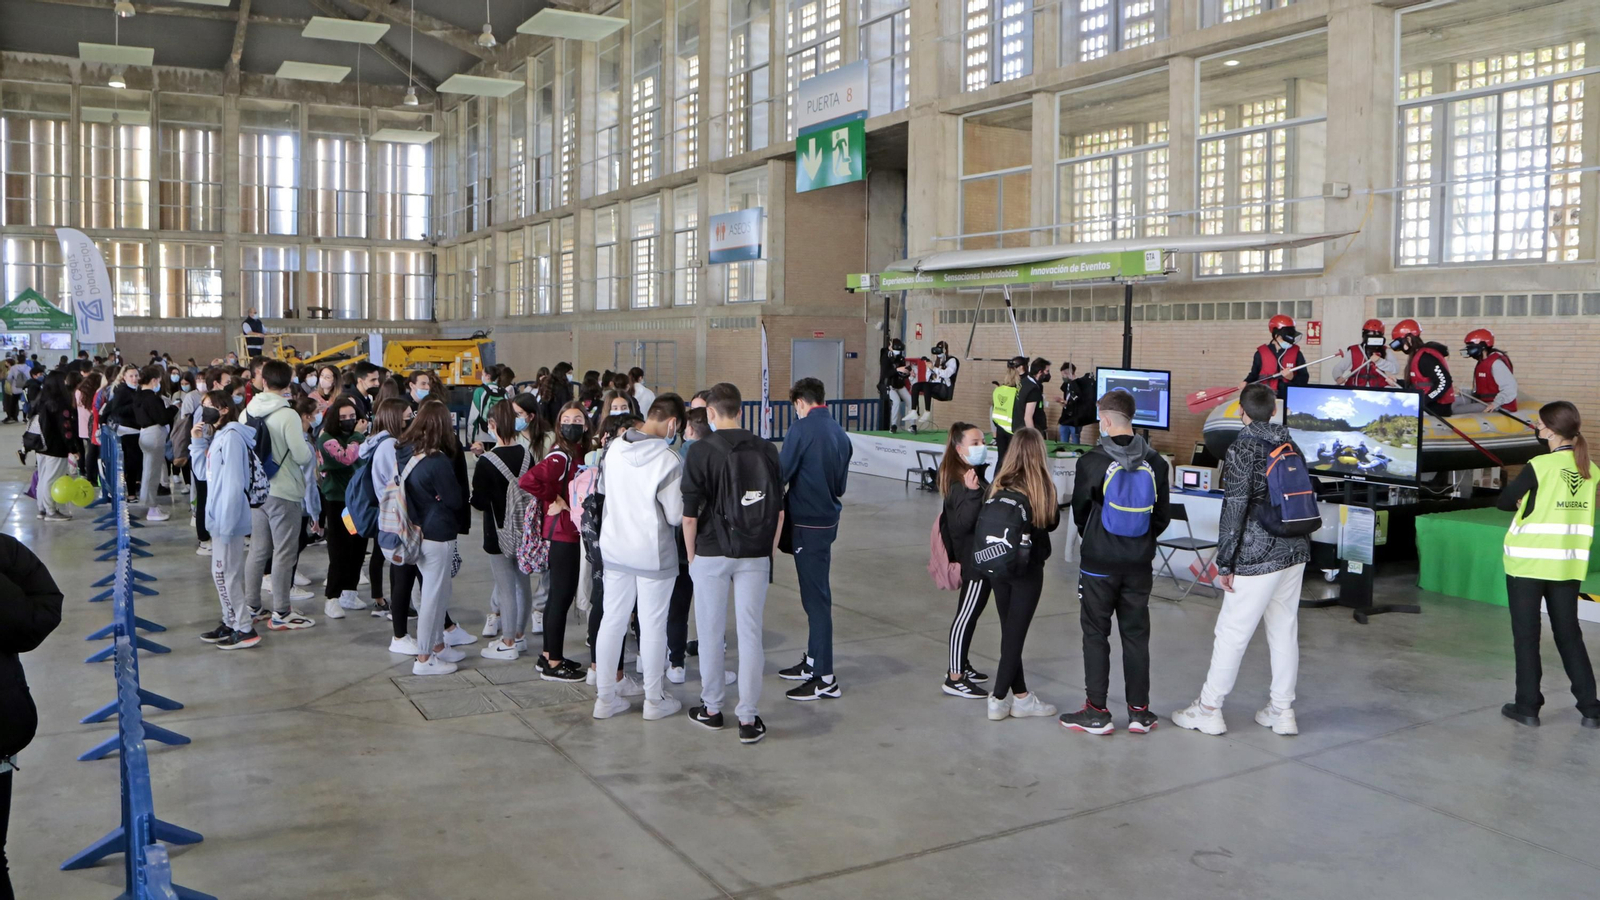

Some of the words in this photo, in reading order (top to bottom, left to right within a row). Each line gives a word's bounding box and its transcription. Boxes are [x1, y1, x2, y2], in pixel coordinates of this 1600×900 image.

[806, 93, 840, 114] PUERTA
[846, 87, 853, 103] 8
[729, 221, 752, 234] ASEOS
[1146, 252, 1155, 261] GTA
[882, 276, 914, 286] Experiencias
[943, 273, 980, 282] Sensaciones
[981, 268, 1019, 280] Inolvidables
[1030, 263, 1069, 276] Innovación
[1070, 263, 1079, 273] de
[1080, 261, 1111, 272] Eventos
[974, 543, 1007, 564] PUMA
